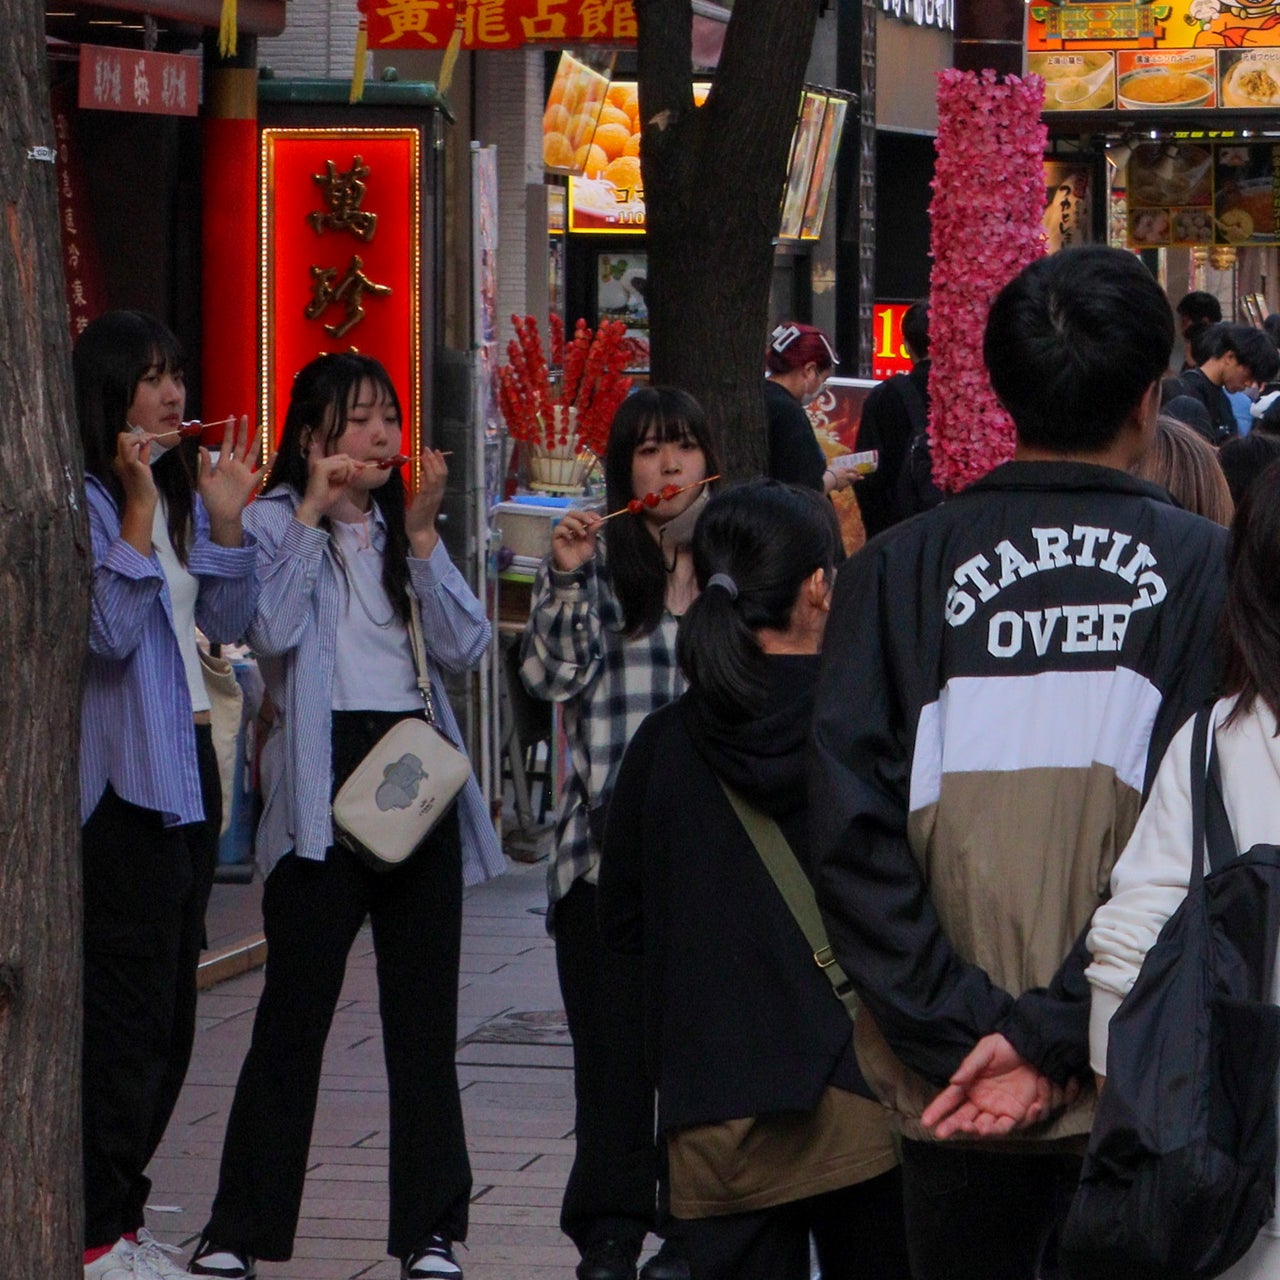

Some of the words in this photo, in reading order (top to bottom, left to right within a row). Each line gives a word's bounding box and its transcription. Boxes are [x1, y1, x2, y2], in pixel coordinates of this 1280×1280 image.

[305, 154, 393, 357] 萬珍
[945, 524, 1168, 627] STARTING
[987, 603, 1134, 659] OVER
